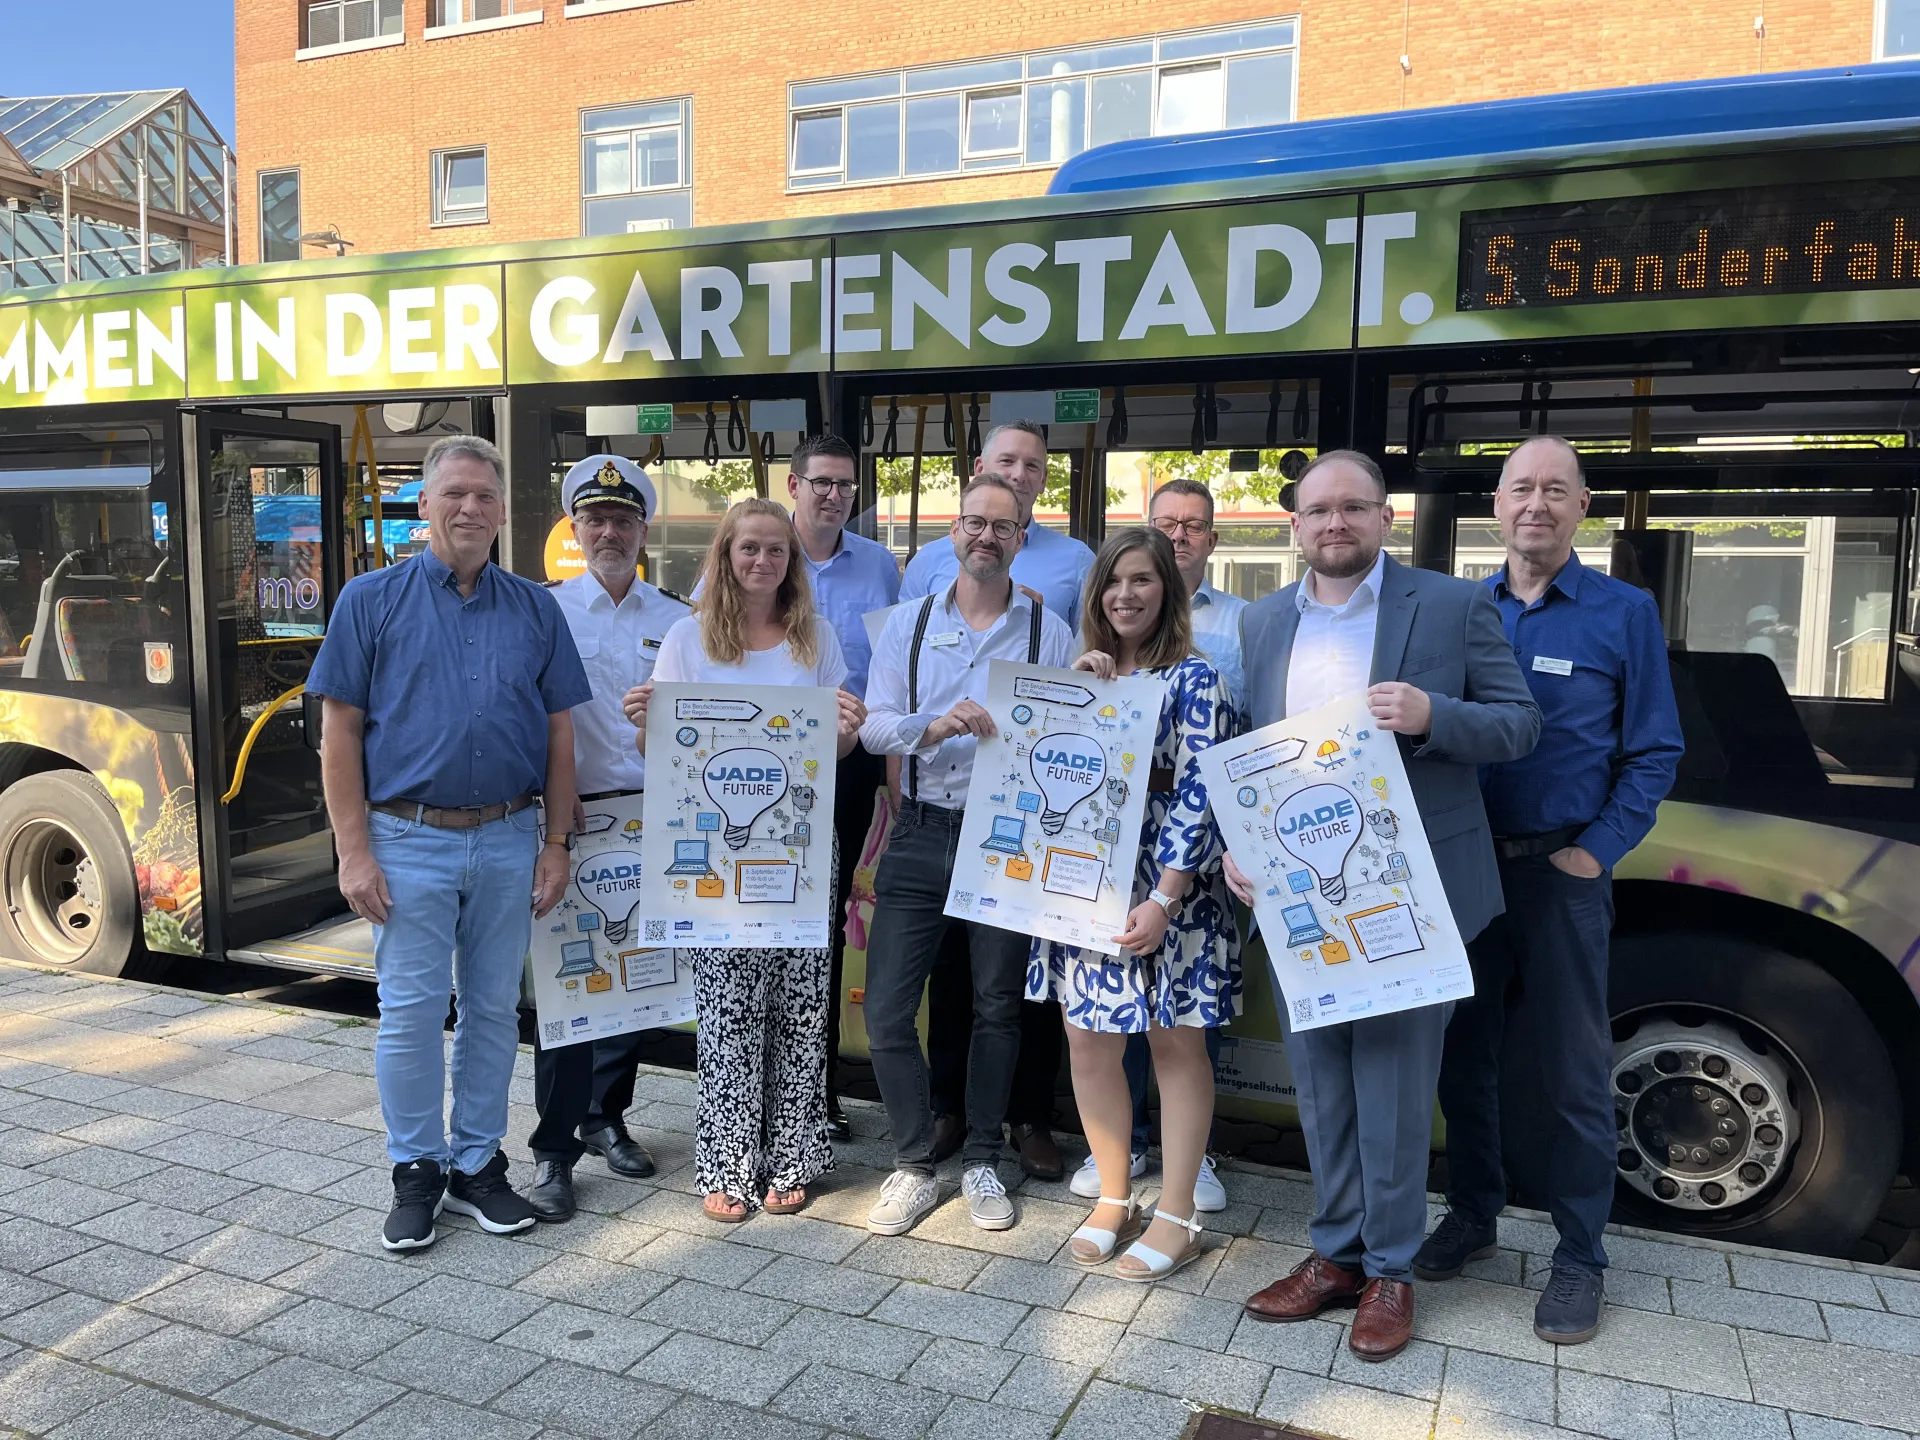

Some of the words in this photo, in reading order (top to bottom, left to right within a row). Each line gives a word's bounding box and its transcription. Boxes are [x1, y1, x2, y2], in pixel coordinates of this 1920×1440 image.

[1547, 217, 1920, 297] Sonderfah
[0, 306, 185, 394] MMEN
[215, 297, 296, 382] IN
[325, 284, 501, 376] DER
[530, 212, 1433, 367] GARTENSTADT.
[1034, 750, 1102, 772] JADE
[708, 767, 782, 782] JADE
[1046, 766, 1093, 785] FUTURE
[723, 784, 774, 796] FUTURE
[1279, 798, 1354, 835] JADE
[1298, 820, 1352, 846] FUTURE
[580, 864, 642, 884] JADE
[596, 878, 641, 894] FUTURE
